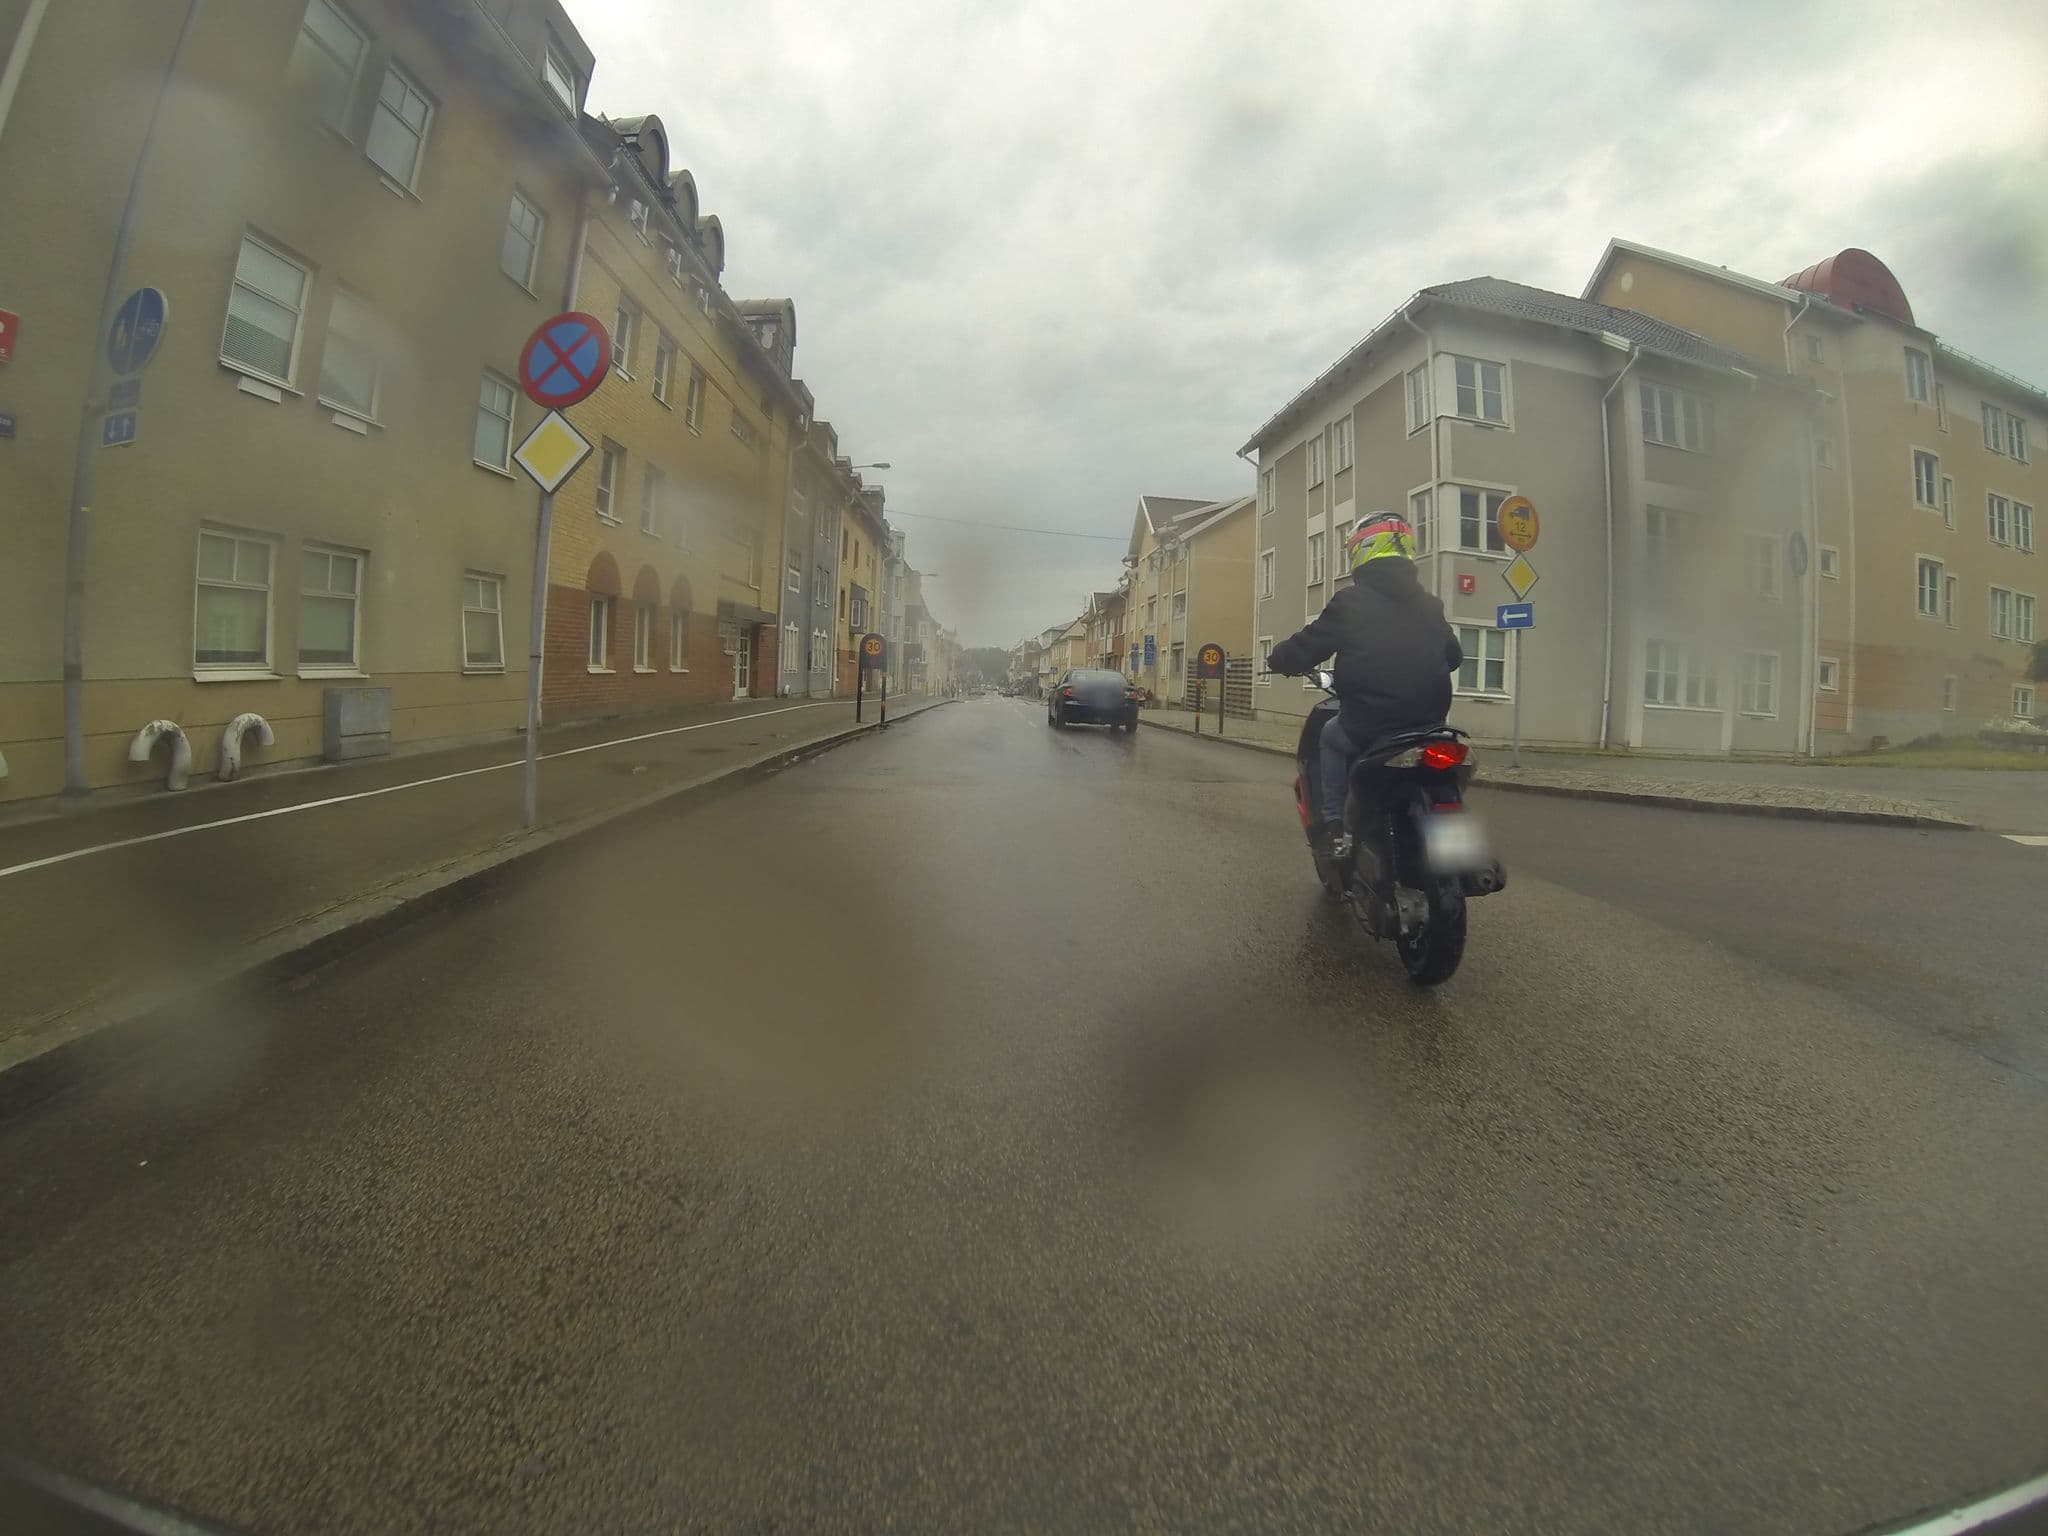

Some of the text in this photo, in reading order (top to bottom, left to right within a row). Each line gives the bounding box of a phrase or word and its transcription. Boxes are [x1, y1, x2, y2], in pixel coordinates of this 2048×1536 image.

[1515, 521, 1527, 532] 12
[867, 641, 881, 652] 30
[1205, 652, 1218, 662] 30
